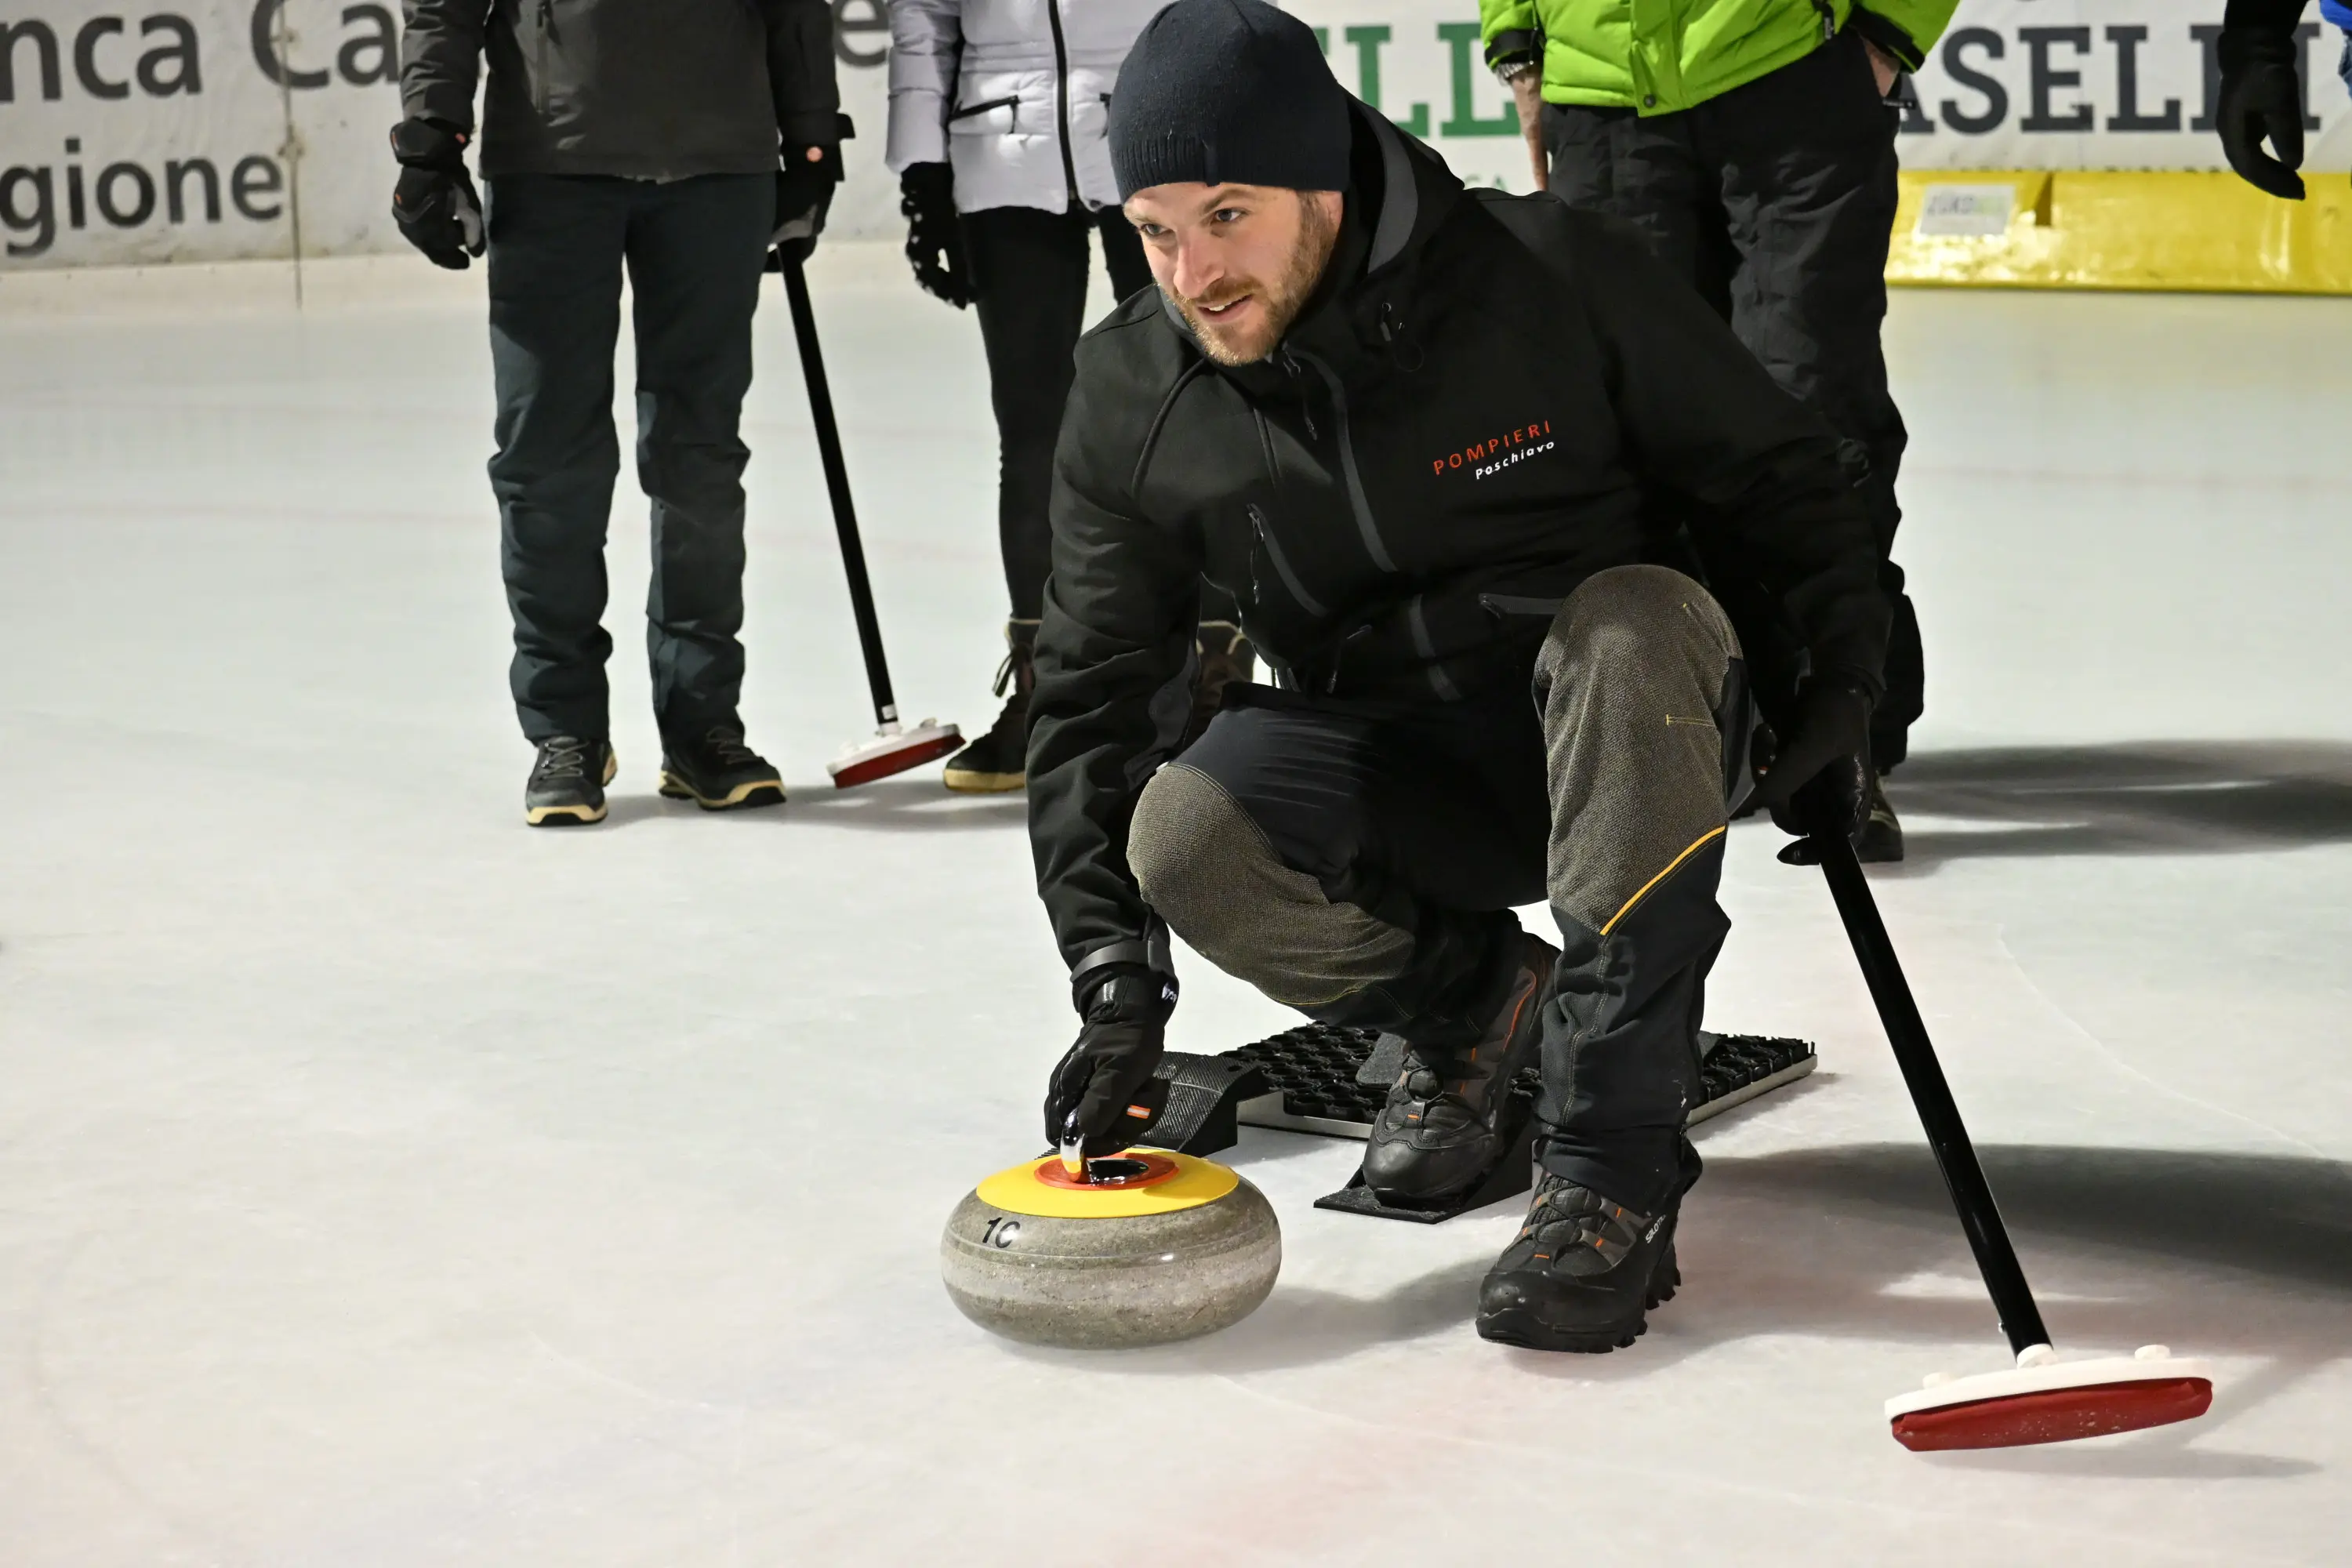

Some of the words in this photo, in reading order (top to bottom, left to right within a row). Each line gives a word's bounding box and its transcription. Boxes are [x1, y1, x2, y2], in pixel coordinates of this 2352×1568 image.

[0, 138, 284, 257] gione
[1433, 420, 1550, 475] POMPIERI
[1475, 441, 1555, 480] Poschiavo
